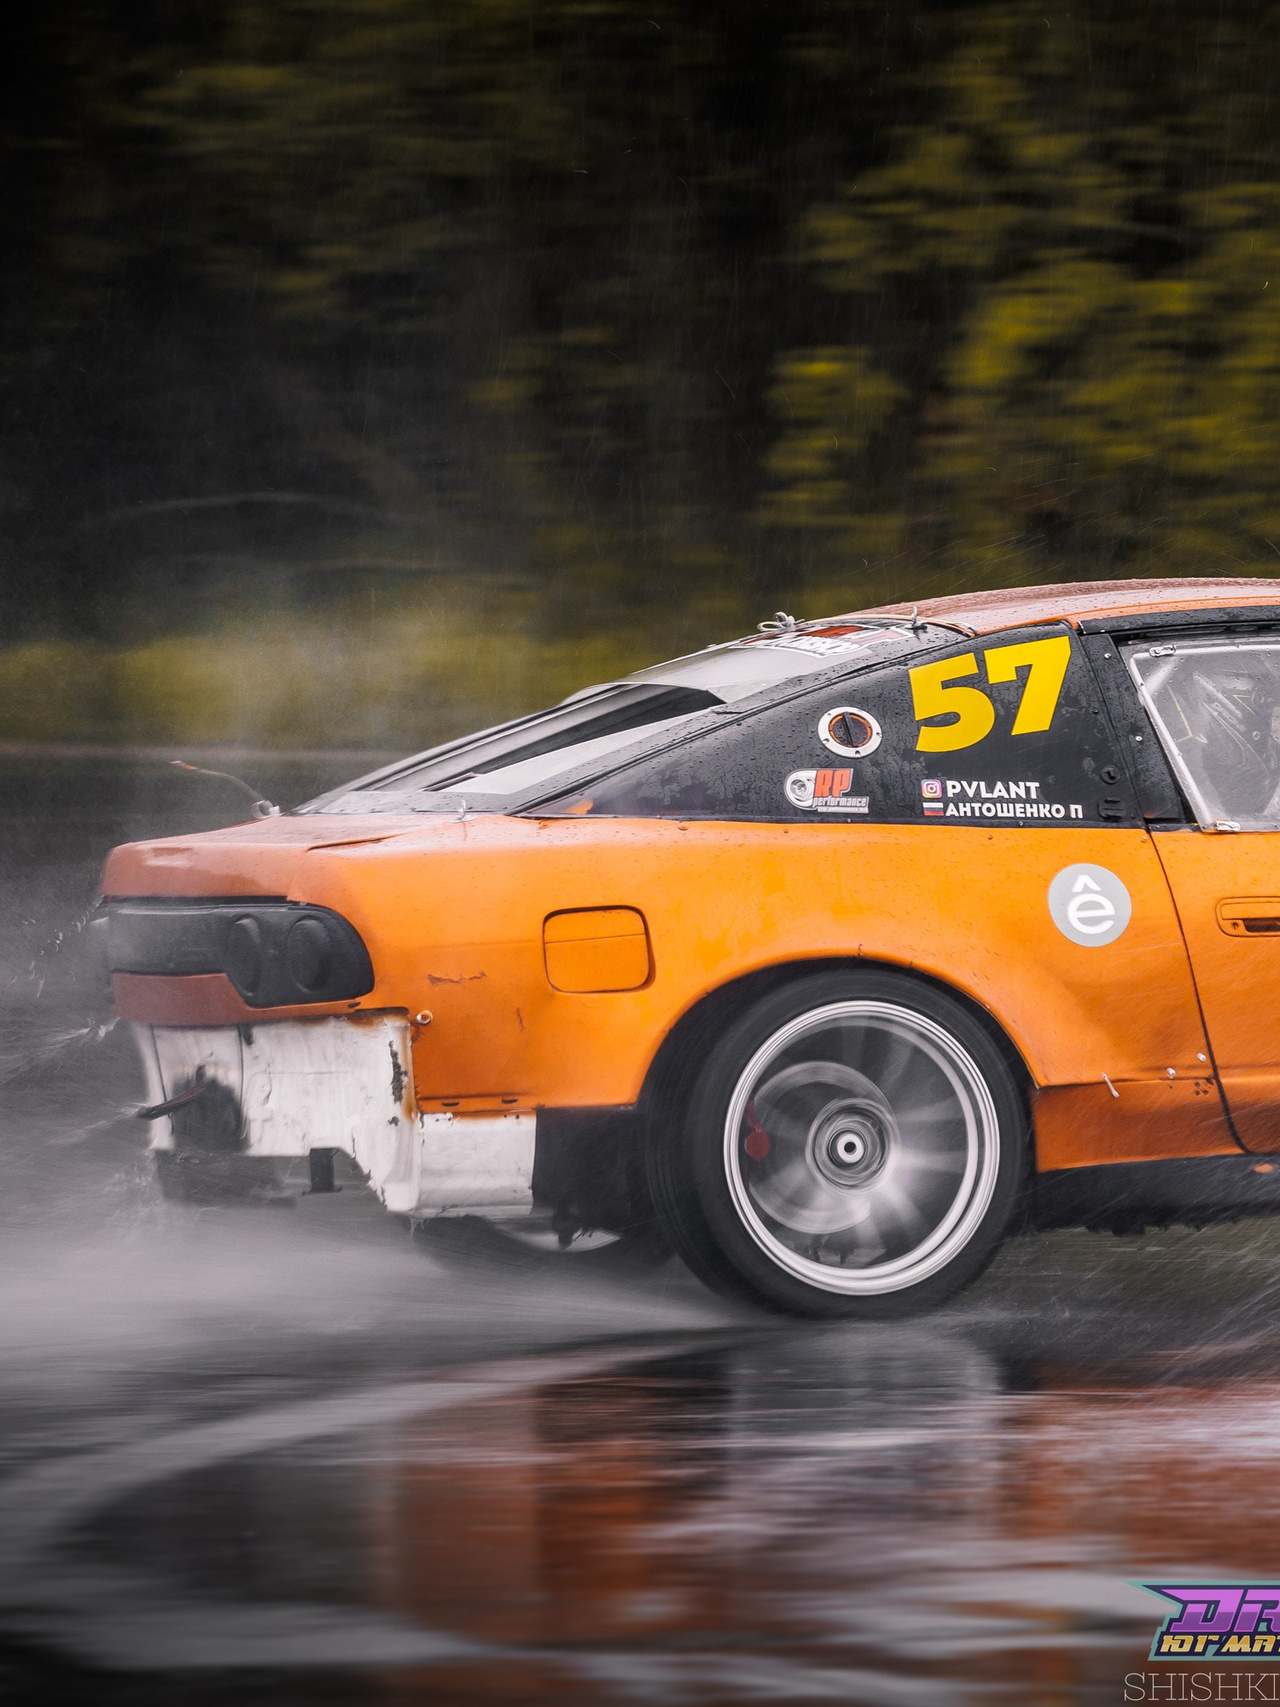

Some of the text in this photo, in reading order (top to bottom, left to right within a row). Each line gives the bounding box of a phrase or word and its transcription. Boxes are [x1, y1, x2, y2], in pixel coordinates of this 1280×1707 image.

[908, 636, 1071, 752] 57
[814, 769, 851, 798] RP
[946, 780, 1040, 799] PVLANT
[812, 795, 867, 807] performance
[945, 802, 1083, 818] АНТОШЕНКО П
